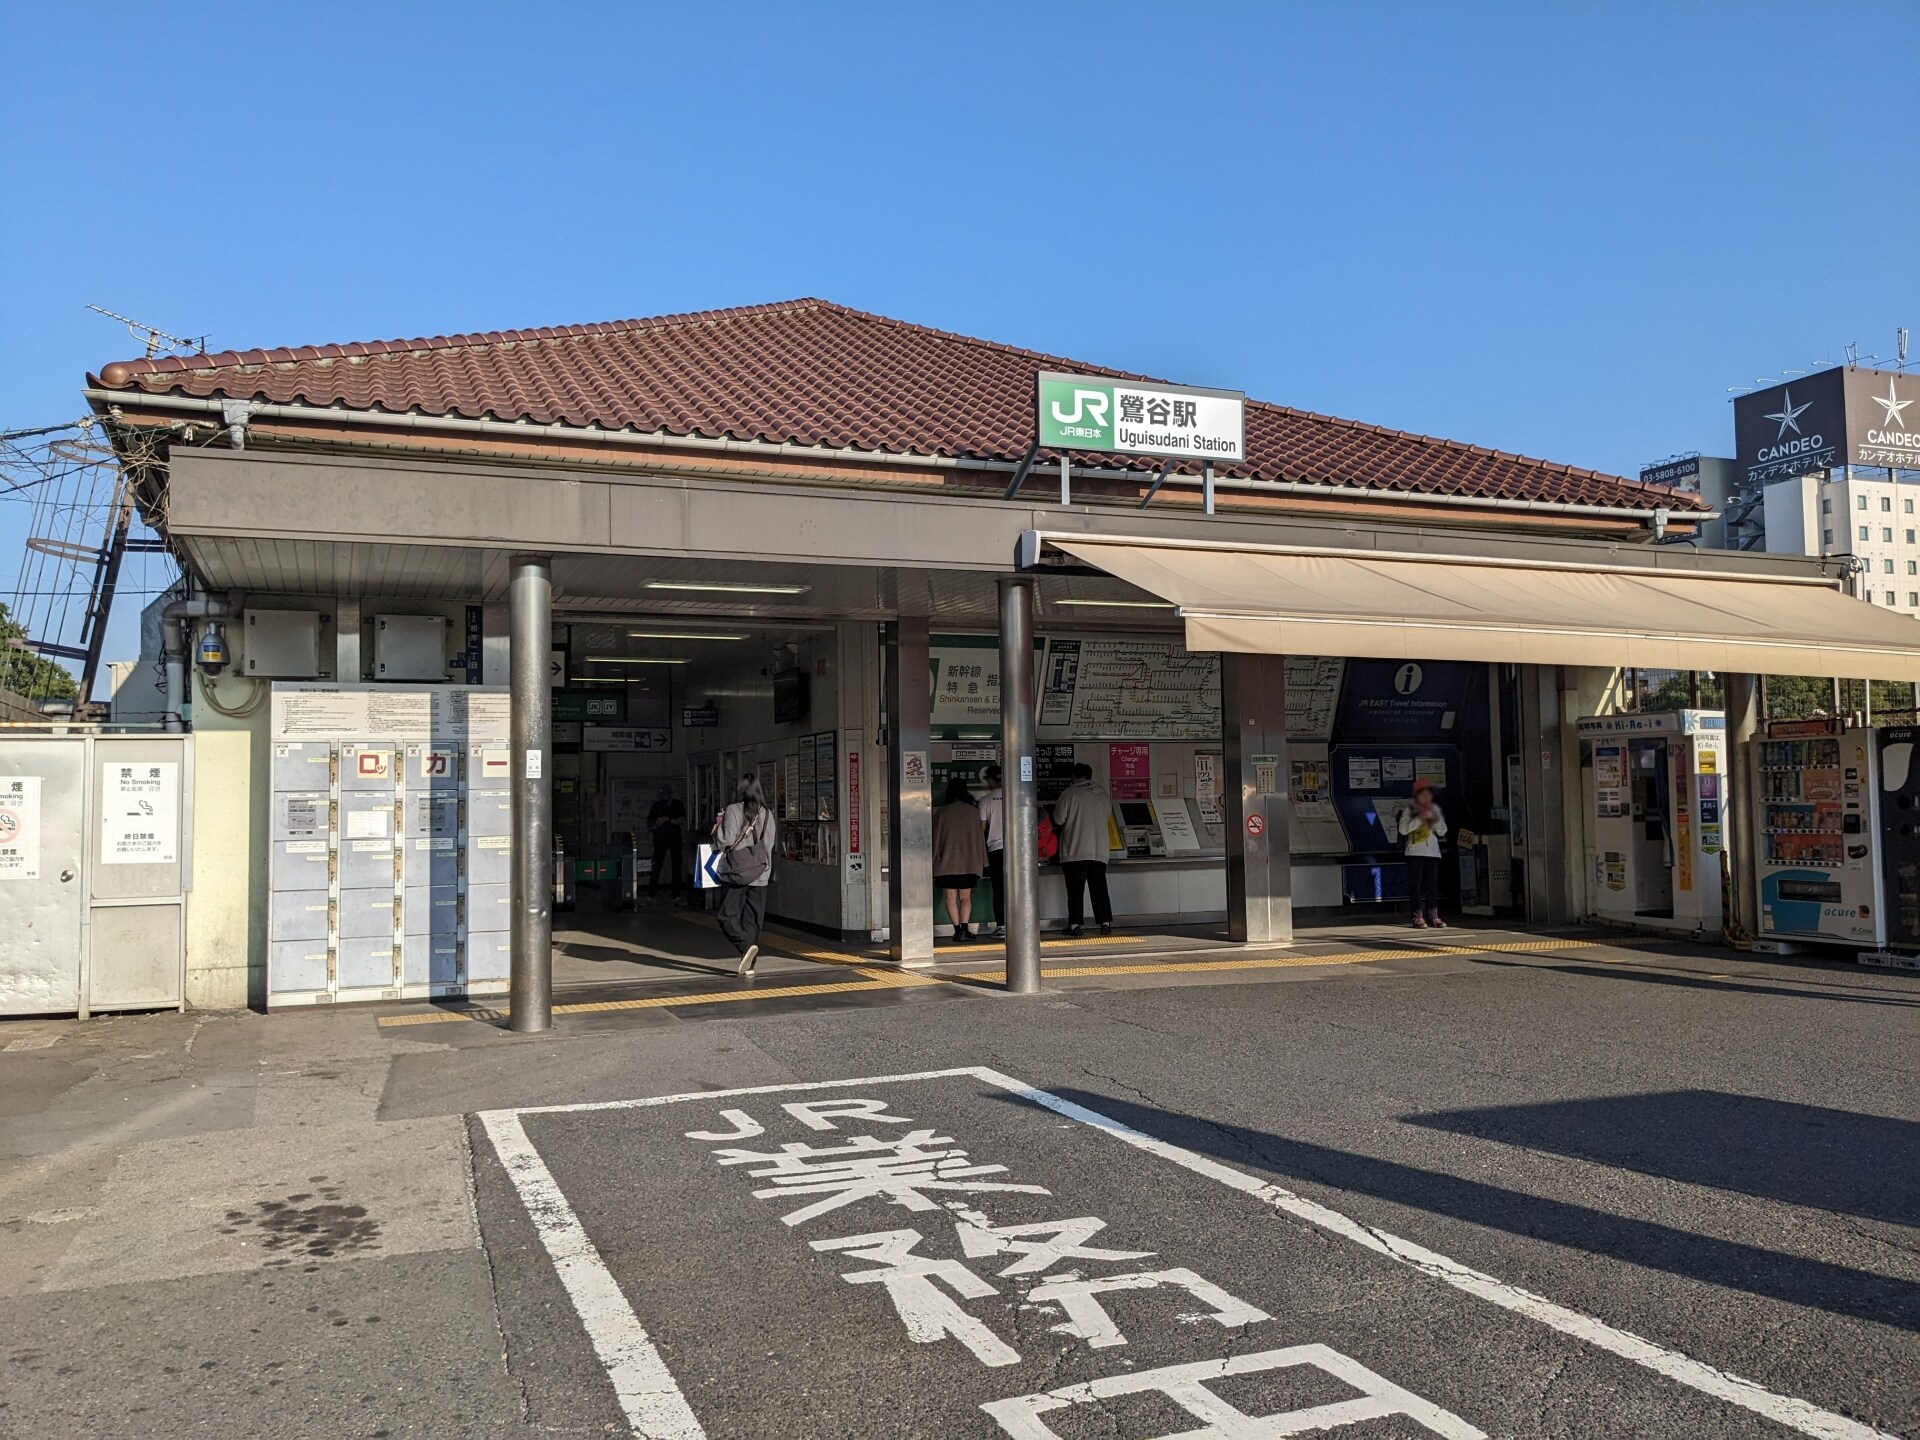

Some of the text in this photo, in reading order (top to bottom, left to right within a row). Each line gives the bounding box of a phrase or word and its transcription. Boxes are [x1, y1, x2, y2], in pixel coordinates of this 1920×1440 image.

[1052, 389, 1109, 426] JR
[1120, 394, 1197, 428] 鶯谷駅
[1060, 426, 1102, 439] JR東日本
[1867, 430, 1920, 448] CANDEO
[1119, 428, 1236, 453] Uguisudani Station
[1758, 434, 1823, 462] CANDEO
[1643, 462, 1696, 483] 03-5808-6100
[1748, 450, 1836, 482] カンデオホテルズ
[947, 665, 982, 678] 新幹線
[986, 674, 1000, 687] 指
[939, 695, 982, 703] Shinkansen
[1369, 699, 1388, 707] EAST
[1578, 722, 1602, 731] 証明写真
[1054, 746, 1073, 756] 定期券
[1110, 746, 1148, 755] チャージ専用
[11, 781, 23, 792] 煙
[1824, 906, 1857, 917] acure
